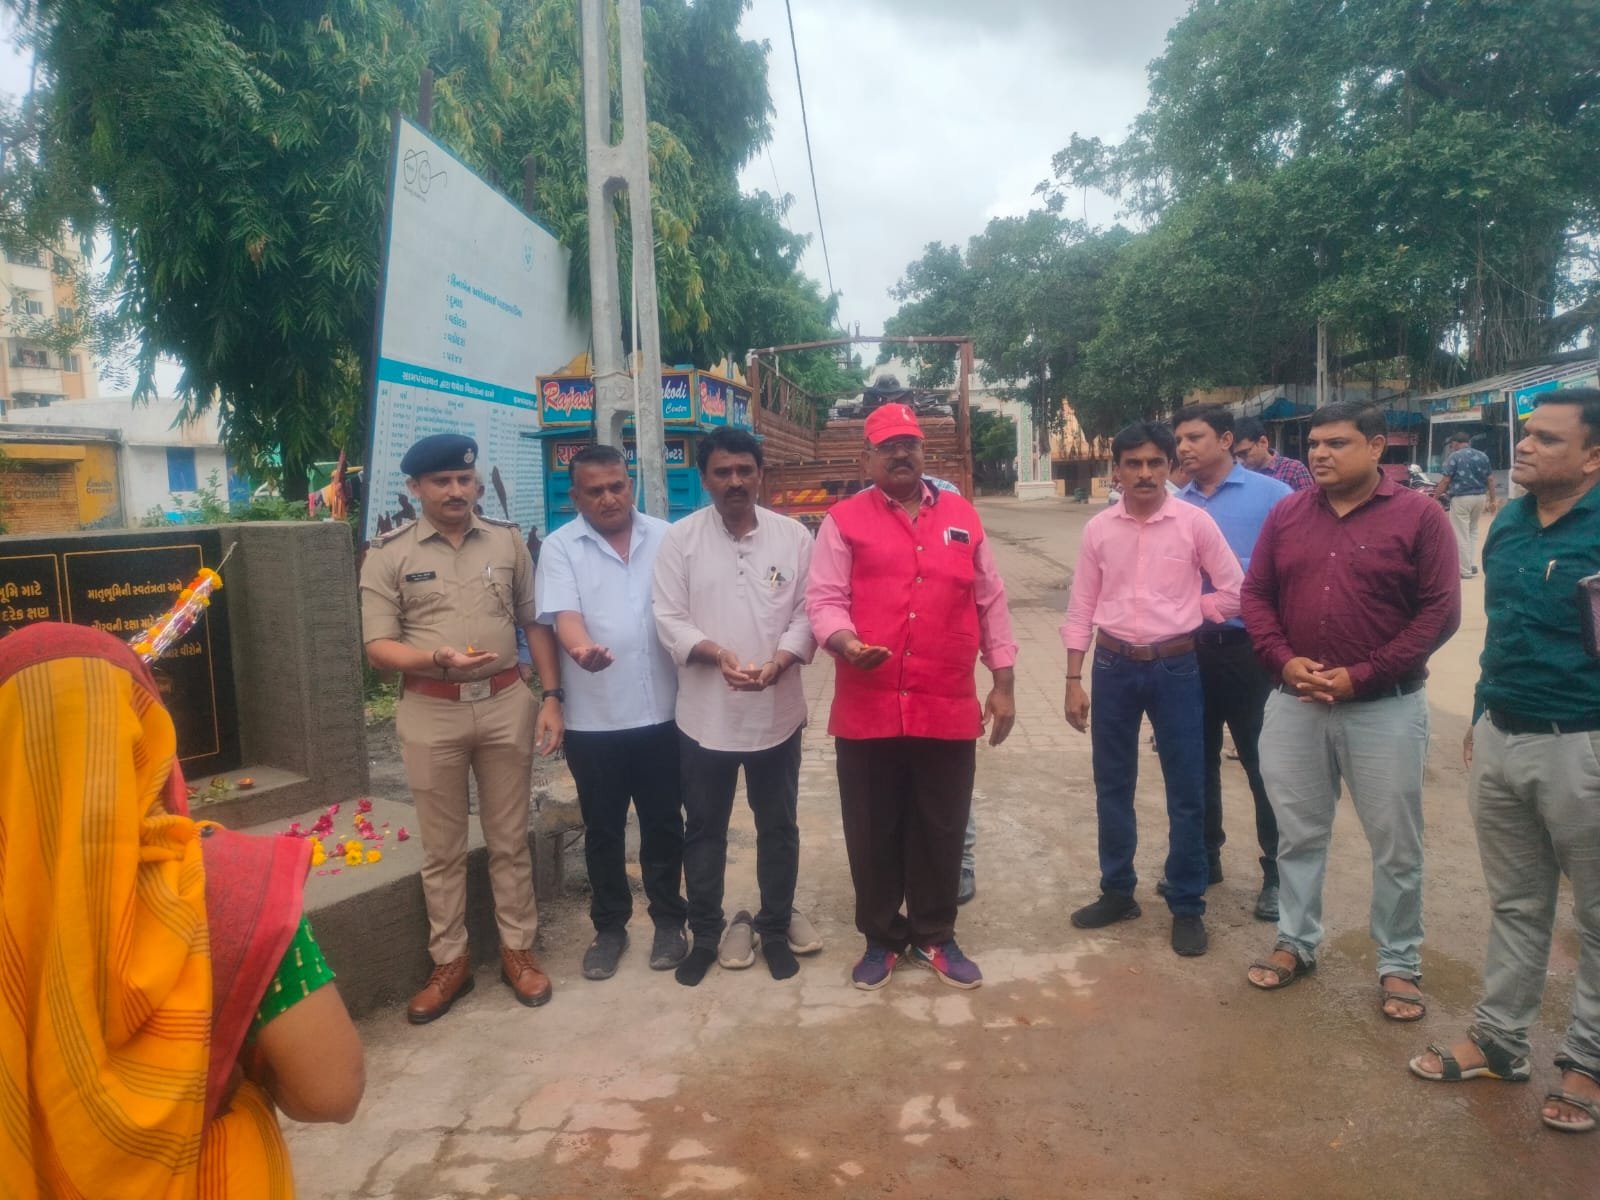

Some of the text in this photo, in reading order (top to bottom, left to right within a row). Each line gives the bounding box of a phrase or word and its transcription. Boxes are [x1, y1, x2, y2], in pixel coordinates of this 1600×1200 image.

[543, 381, 594, 417] Rajast
[21, 580, 43, 597] માટે
[87, 578, 183, 603] માતૃભૂમિની સ્વતંત્રતા અને
[2, 605, 50, 622] દરેક ક્ષણ
[124, 617, 139, 631] રક્ષા
